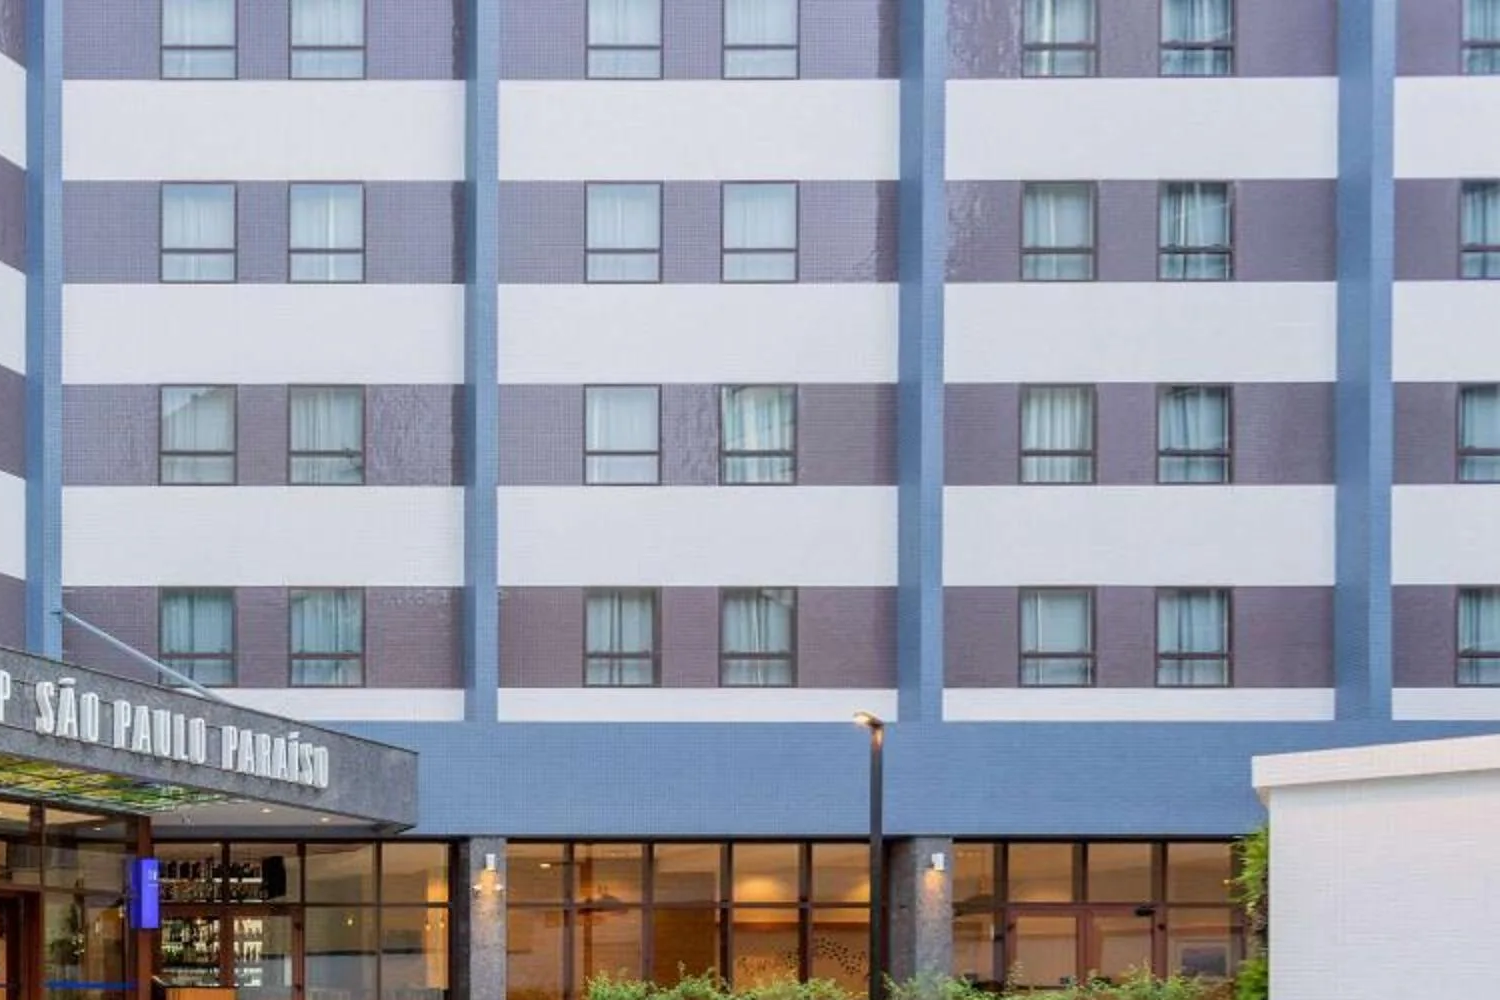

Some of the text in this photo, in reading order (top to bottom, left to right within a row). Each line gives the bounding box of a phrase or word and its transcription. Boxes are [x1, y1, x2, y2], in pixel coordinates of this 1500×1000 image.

[35, 677, 99, 743] SÃO
[113, 700, 205, 764] PAULO
[221, 725, 329, 789] PARAÍSO
